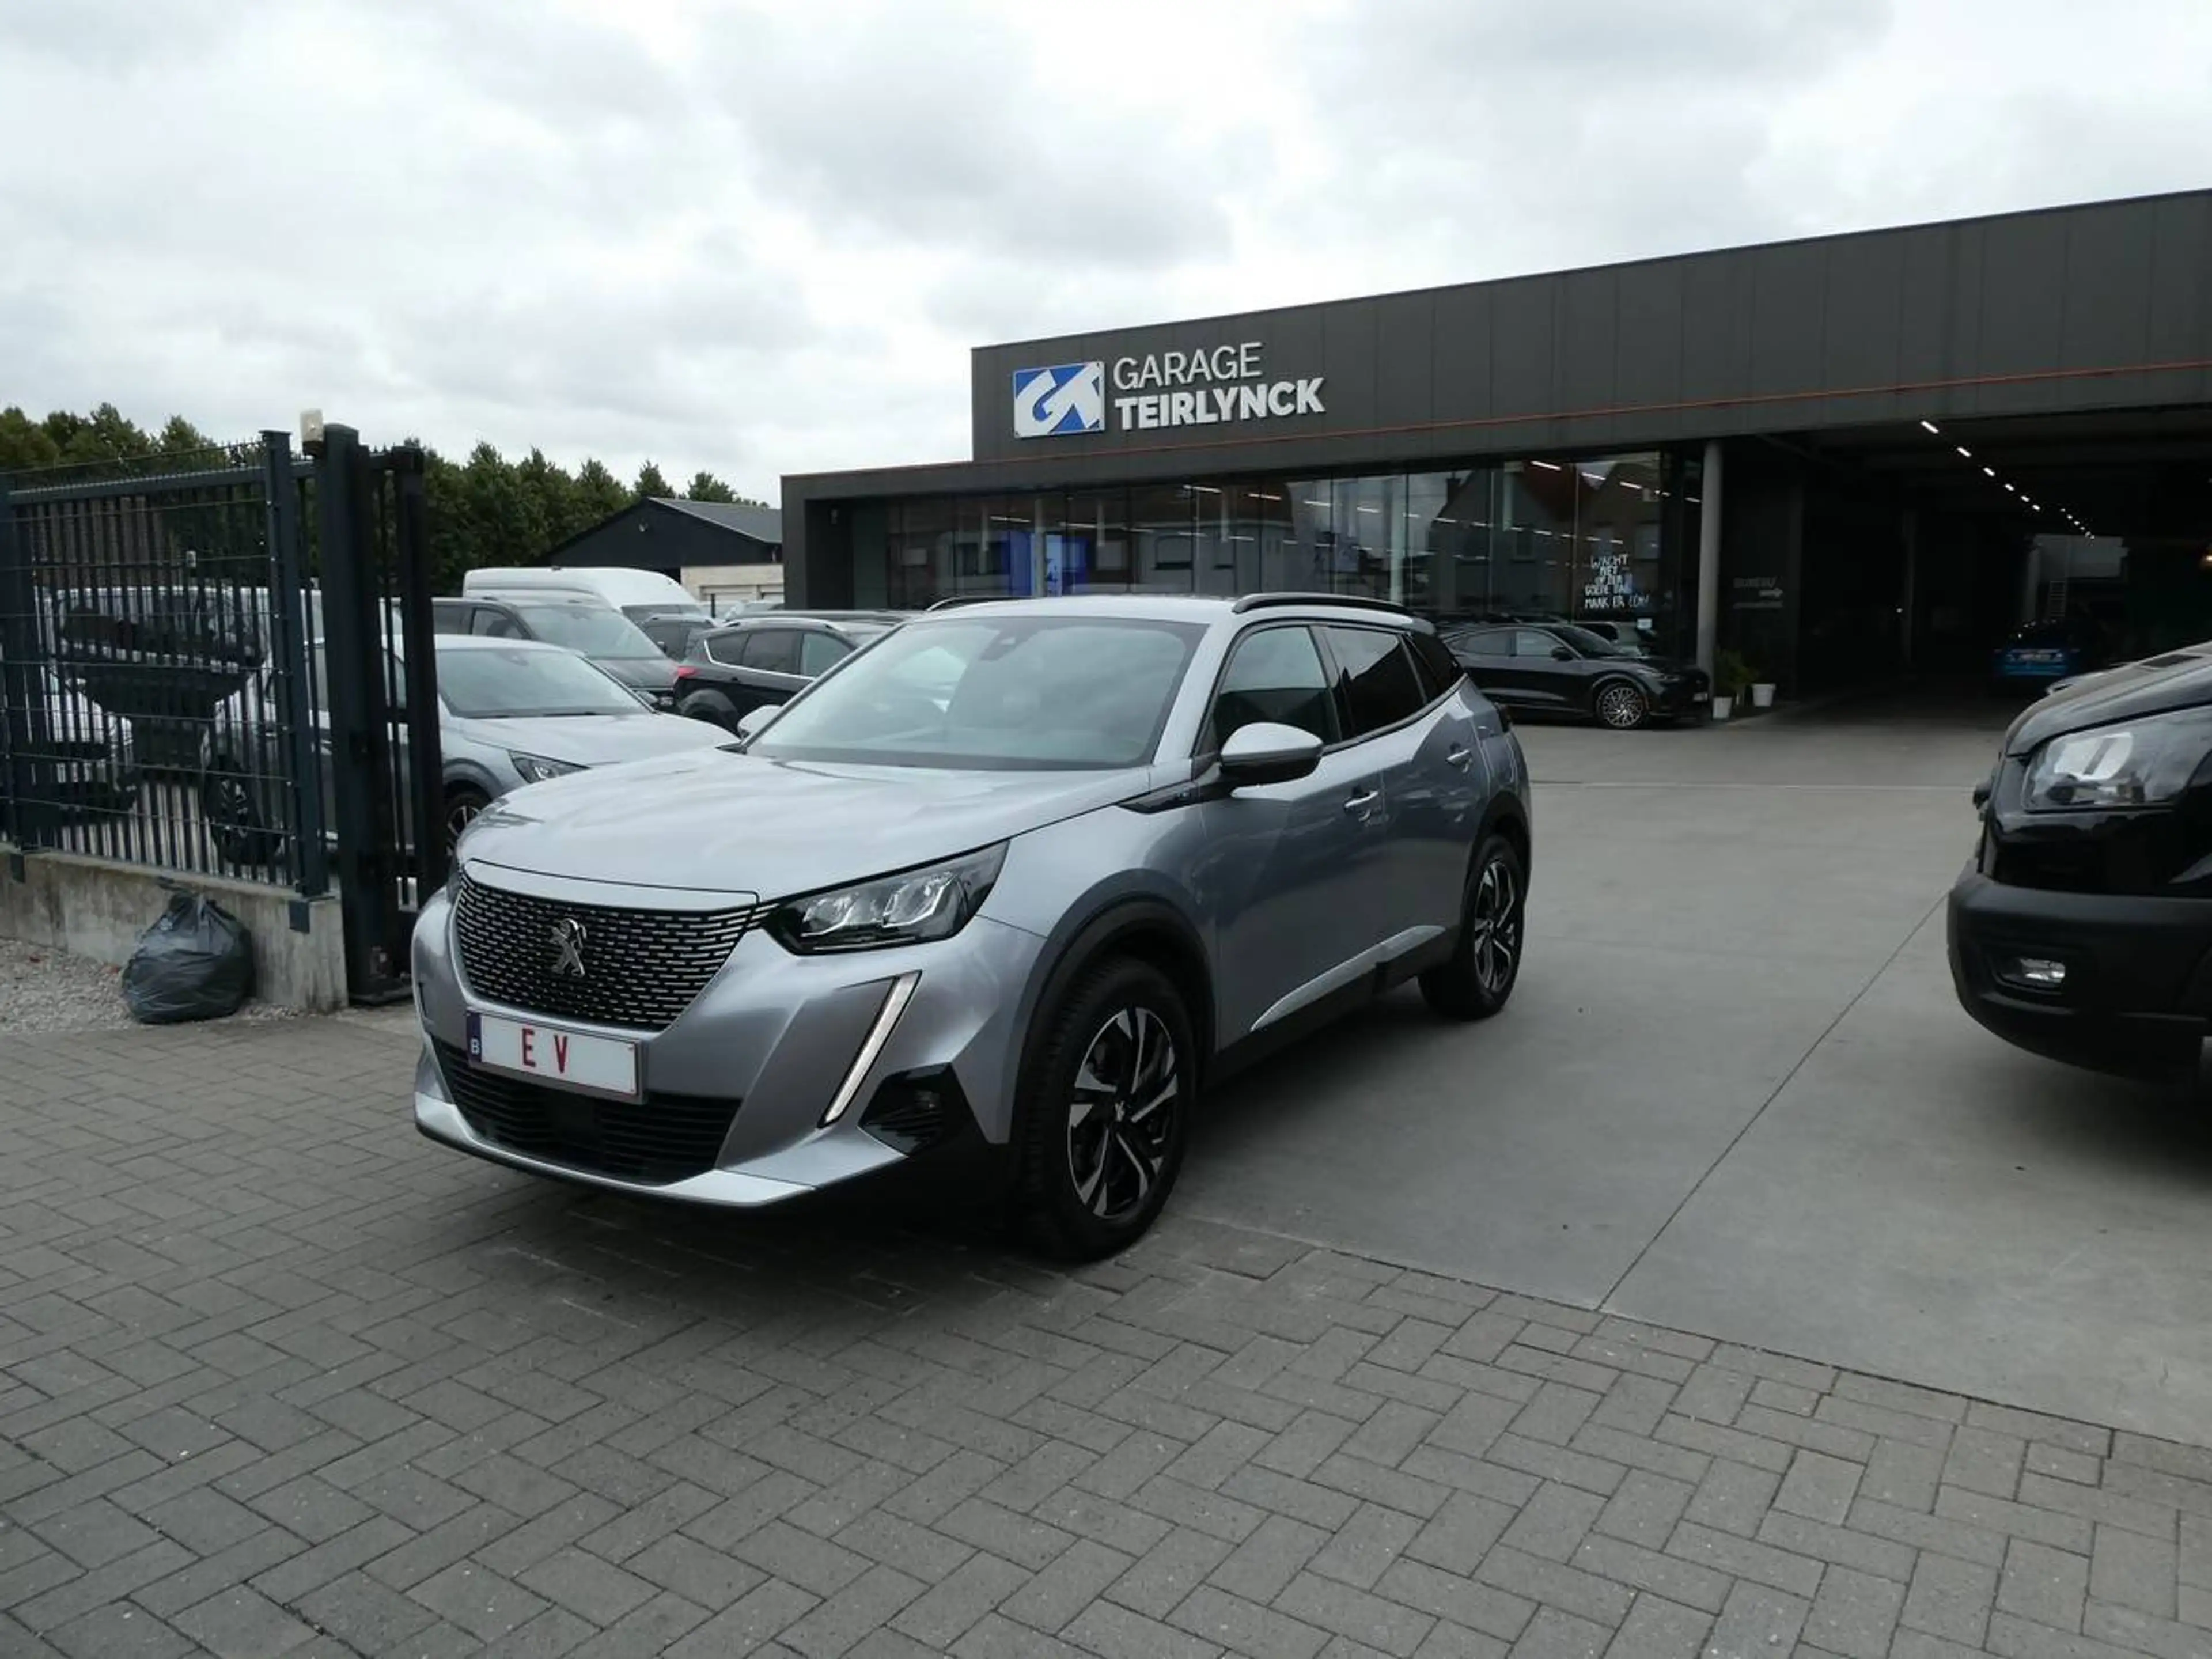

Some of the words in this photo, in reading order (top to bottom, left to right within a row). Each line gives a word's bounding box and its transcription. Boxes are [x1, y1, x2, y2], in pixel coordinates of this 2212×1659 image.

[1113, 342, 1263, 391] GARAGE
[1115, 377, 1325, 430] TEIRLYNCK
[469, 1037, 480, 1055] B
